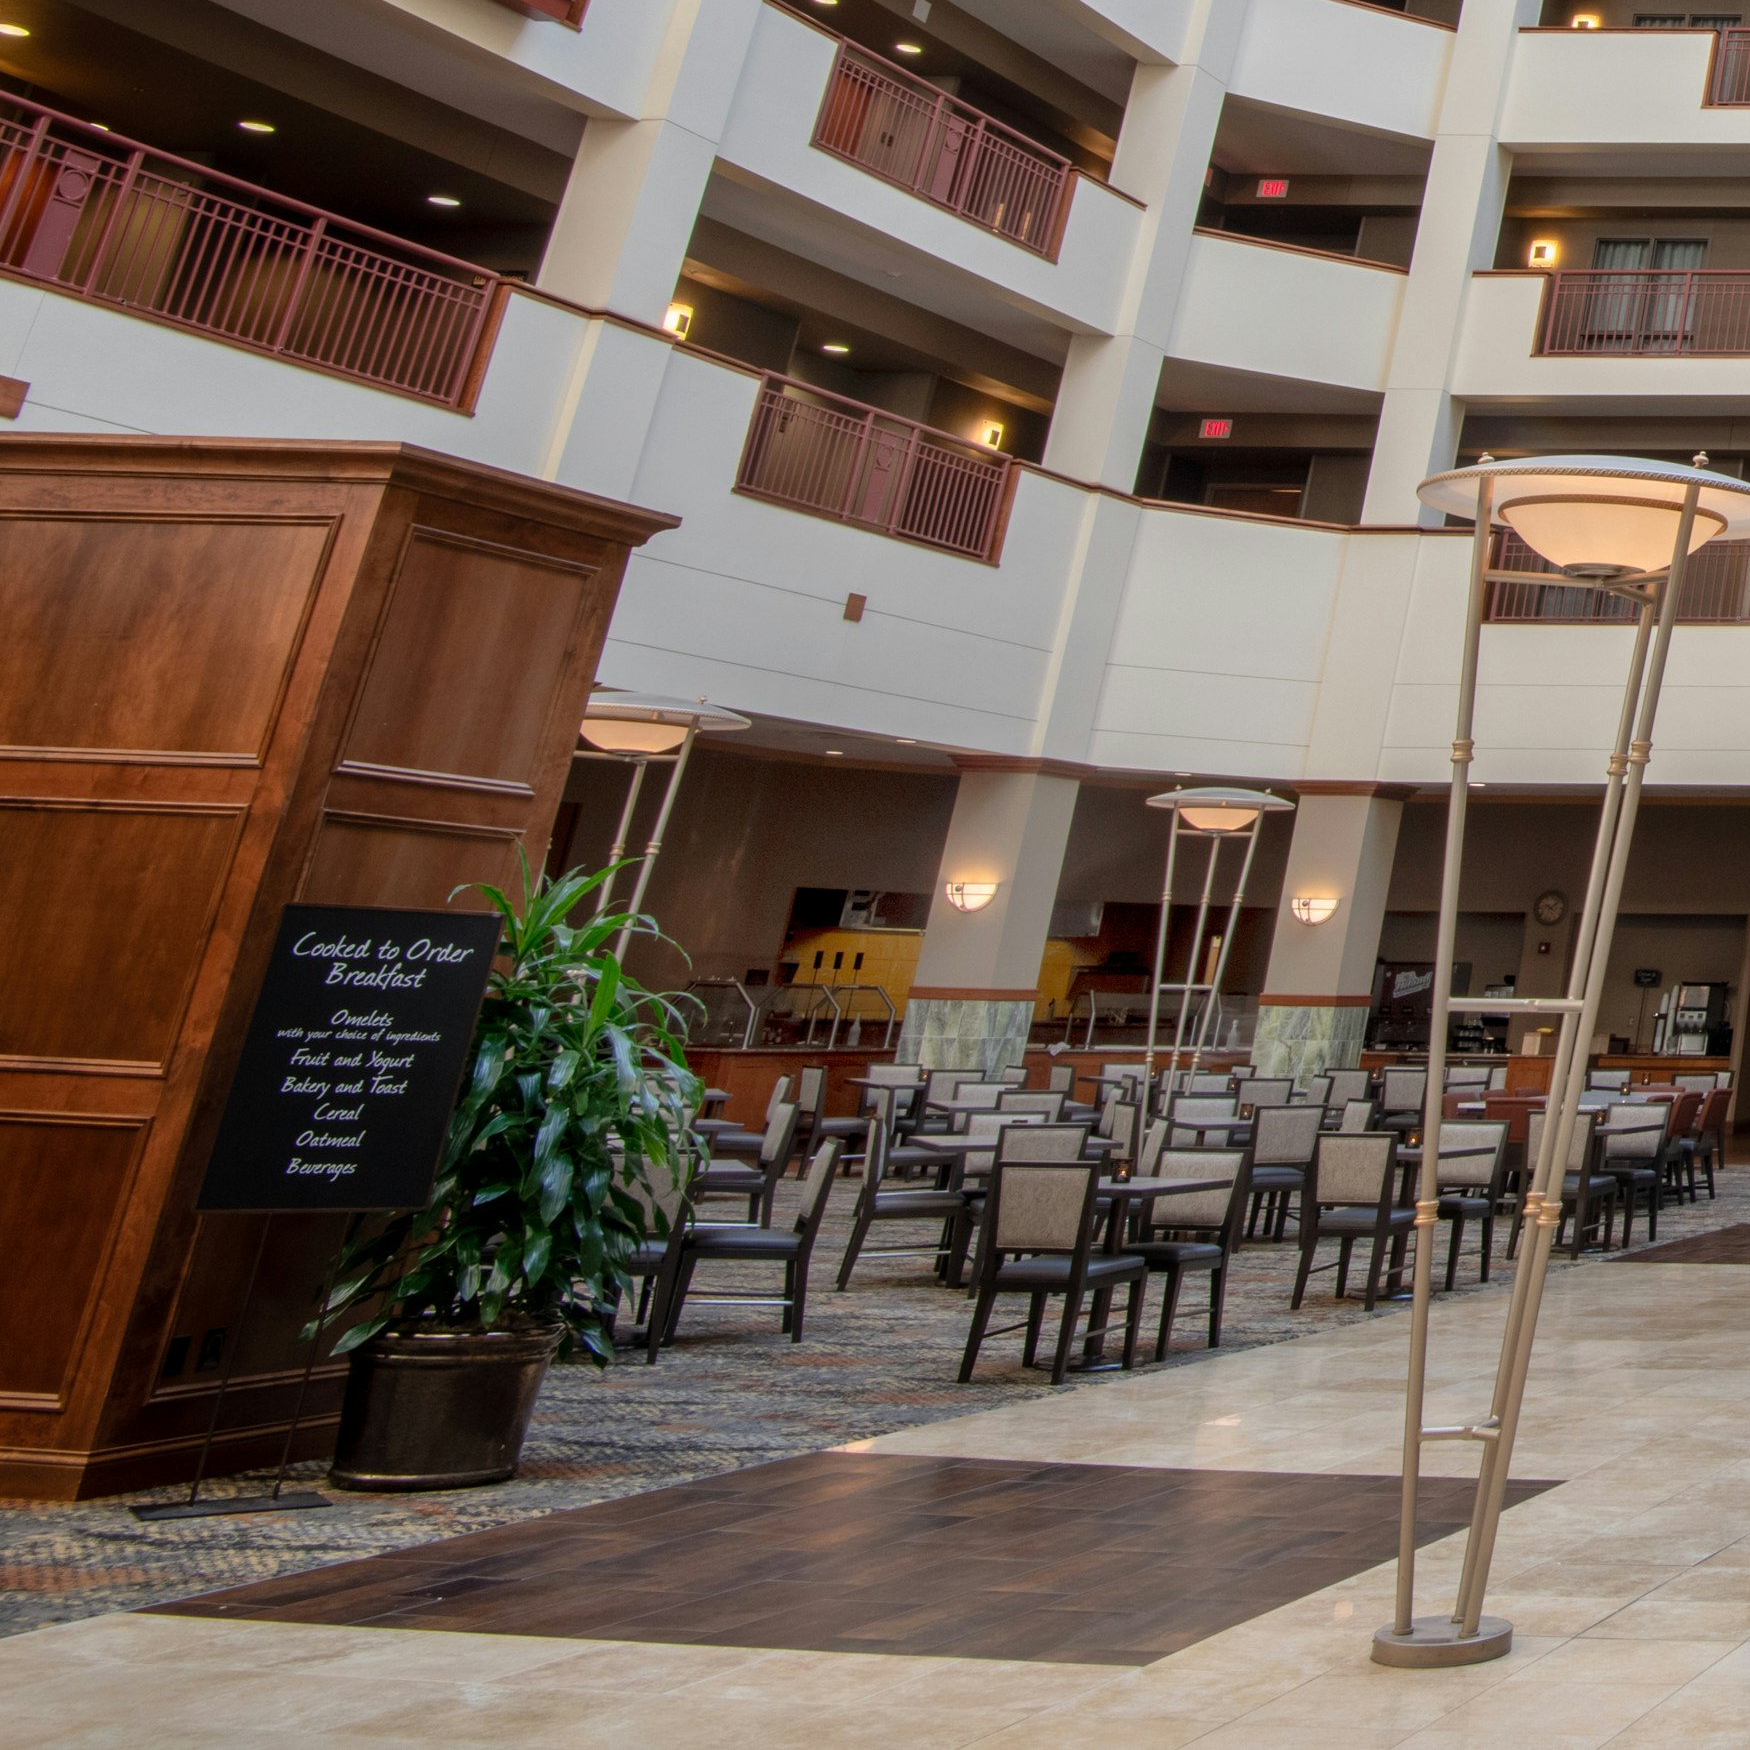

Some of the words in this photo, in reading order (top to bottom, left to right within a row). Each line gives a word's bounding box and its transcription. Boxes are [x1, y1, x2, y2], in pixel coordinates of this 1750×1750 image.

[1262, 181, 1284, 196] EXIT
[1205, 421, 1227, 437] EXIT
[292, 931, 372, 959] Cooked
[376, 939, 400, 960] to
[405, 938, 475, 963] Order
[324, 962, 427, 990] Breakfast
[330, 1009, 394, 1027] Omelets
[277, 1028, 303, 1038] with
[304, 1030, 332, 1042] your
[335, 1028, 368, 1040] choice
[371, 1028, 386, 1041] of
[386, 1031, 441, 1046] ingredients
[290, 1048, 331, 1066] Fruit
[334, 1052, 363, 1067] and
[365, 1050, 415, 1075] Yogurt
[280, 1076, 331, 1100] Bakery
[335, 1080, 364, 1094] and
[370, 1075, 408, 1094] Toast
[313, 1102, 365, 1120] Cereal
[295, 1129, 366, 1147] Oatmeal
[286, 1157, 357, 1182] Beverages
